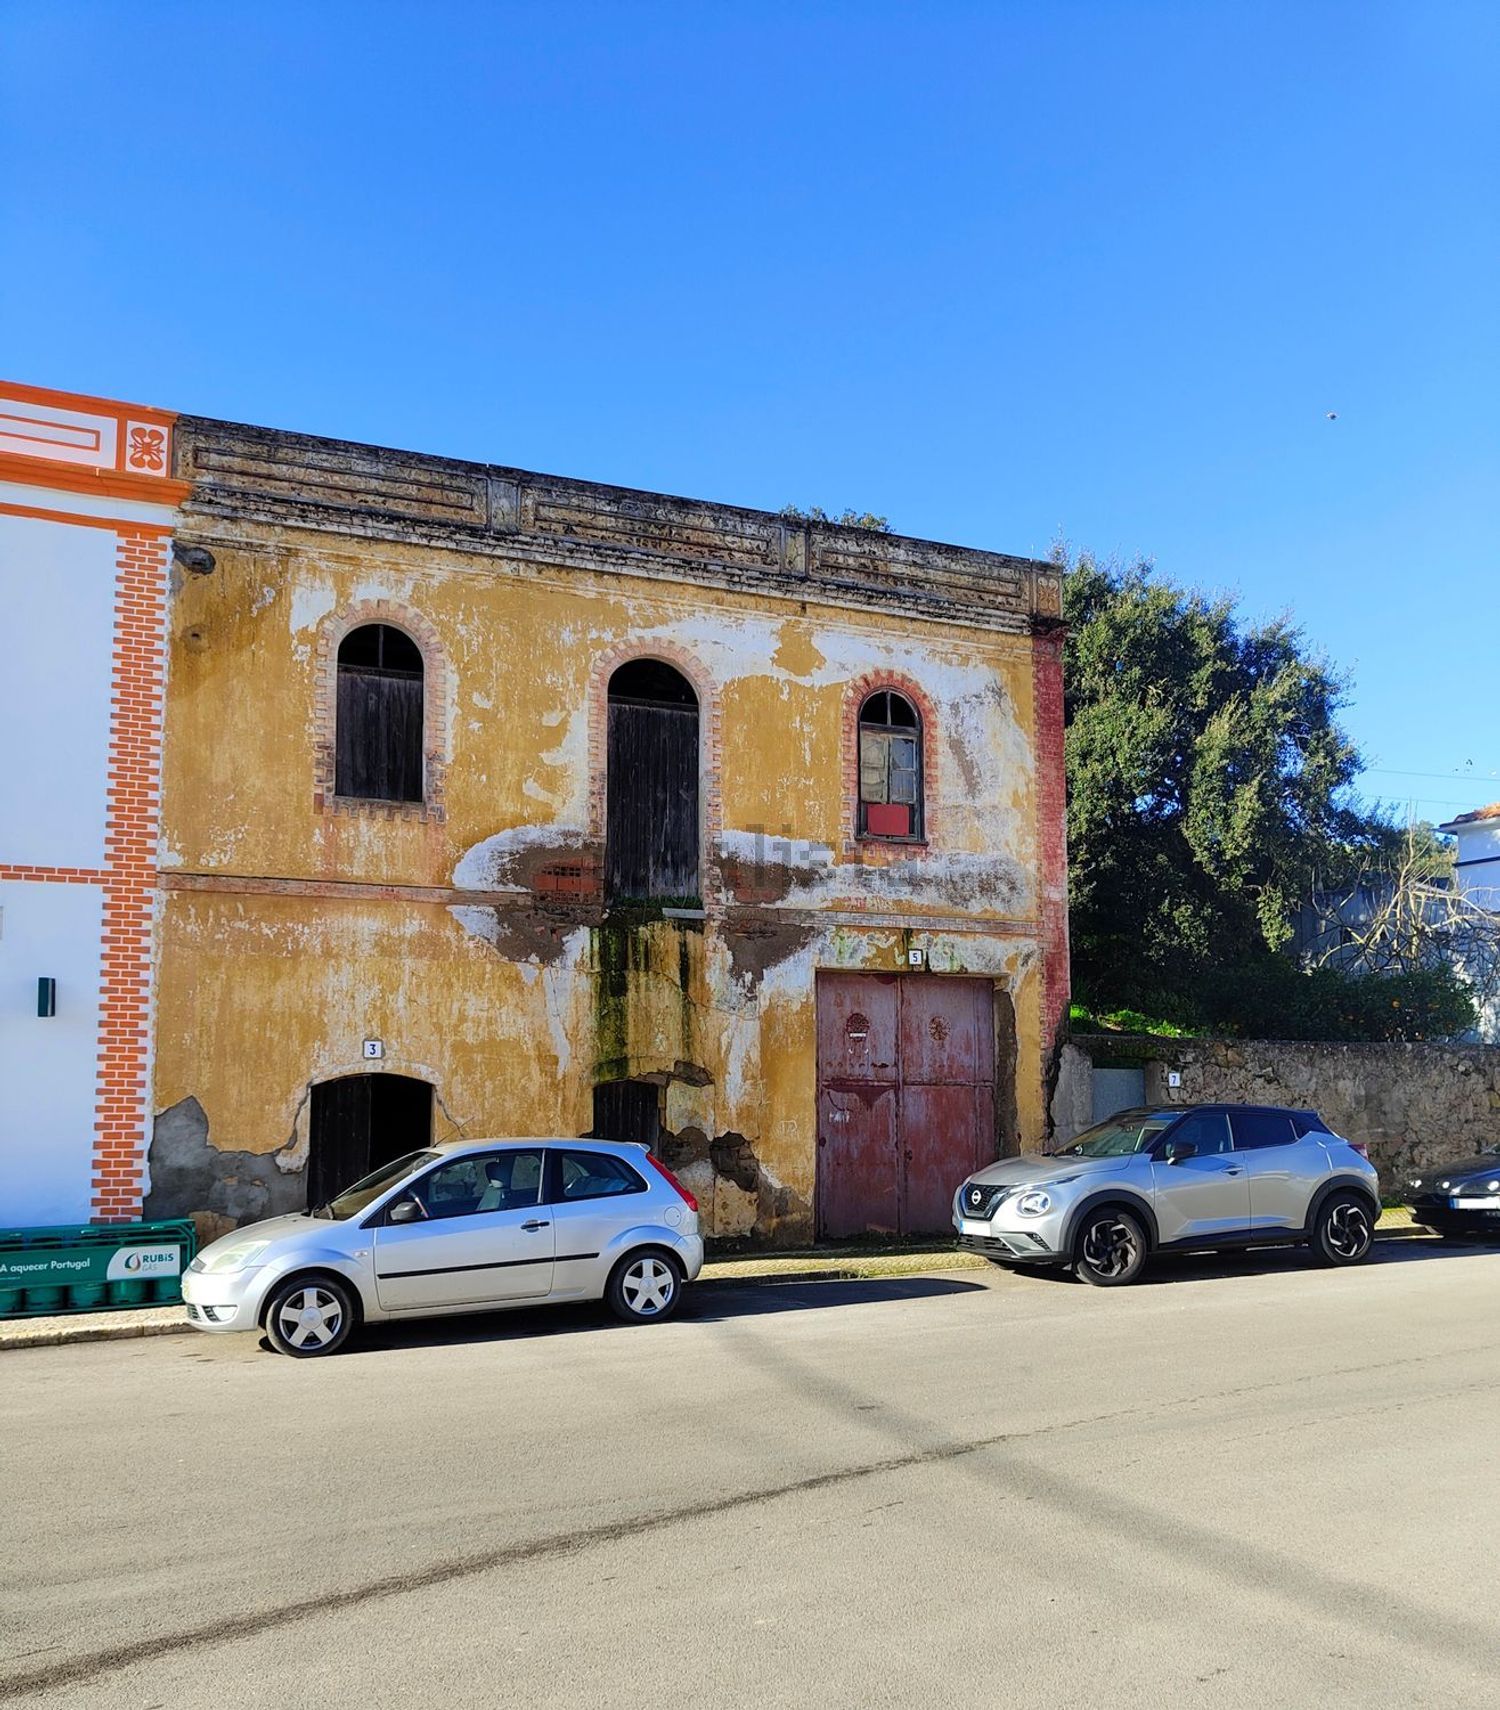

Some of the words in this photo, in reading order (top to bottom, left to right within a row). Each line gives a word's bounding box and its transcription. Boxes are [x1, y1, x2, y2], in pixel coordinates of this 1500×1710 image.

[912, 952, 919, 963] 5
[369, 1043, 377, 1056] 3
[1171, 1074, 1177, 1085] 7
[0, 1263, 8, 1273] A
[10, 1263, 49, 1274] aquecer
[50, 1257, 91, 1270] Portugal
